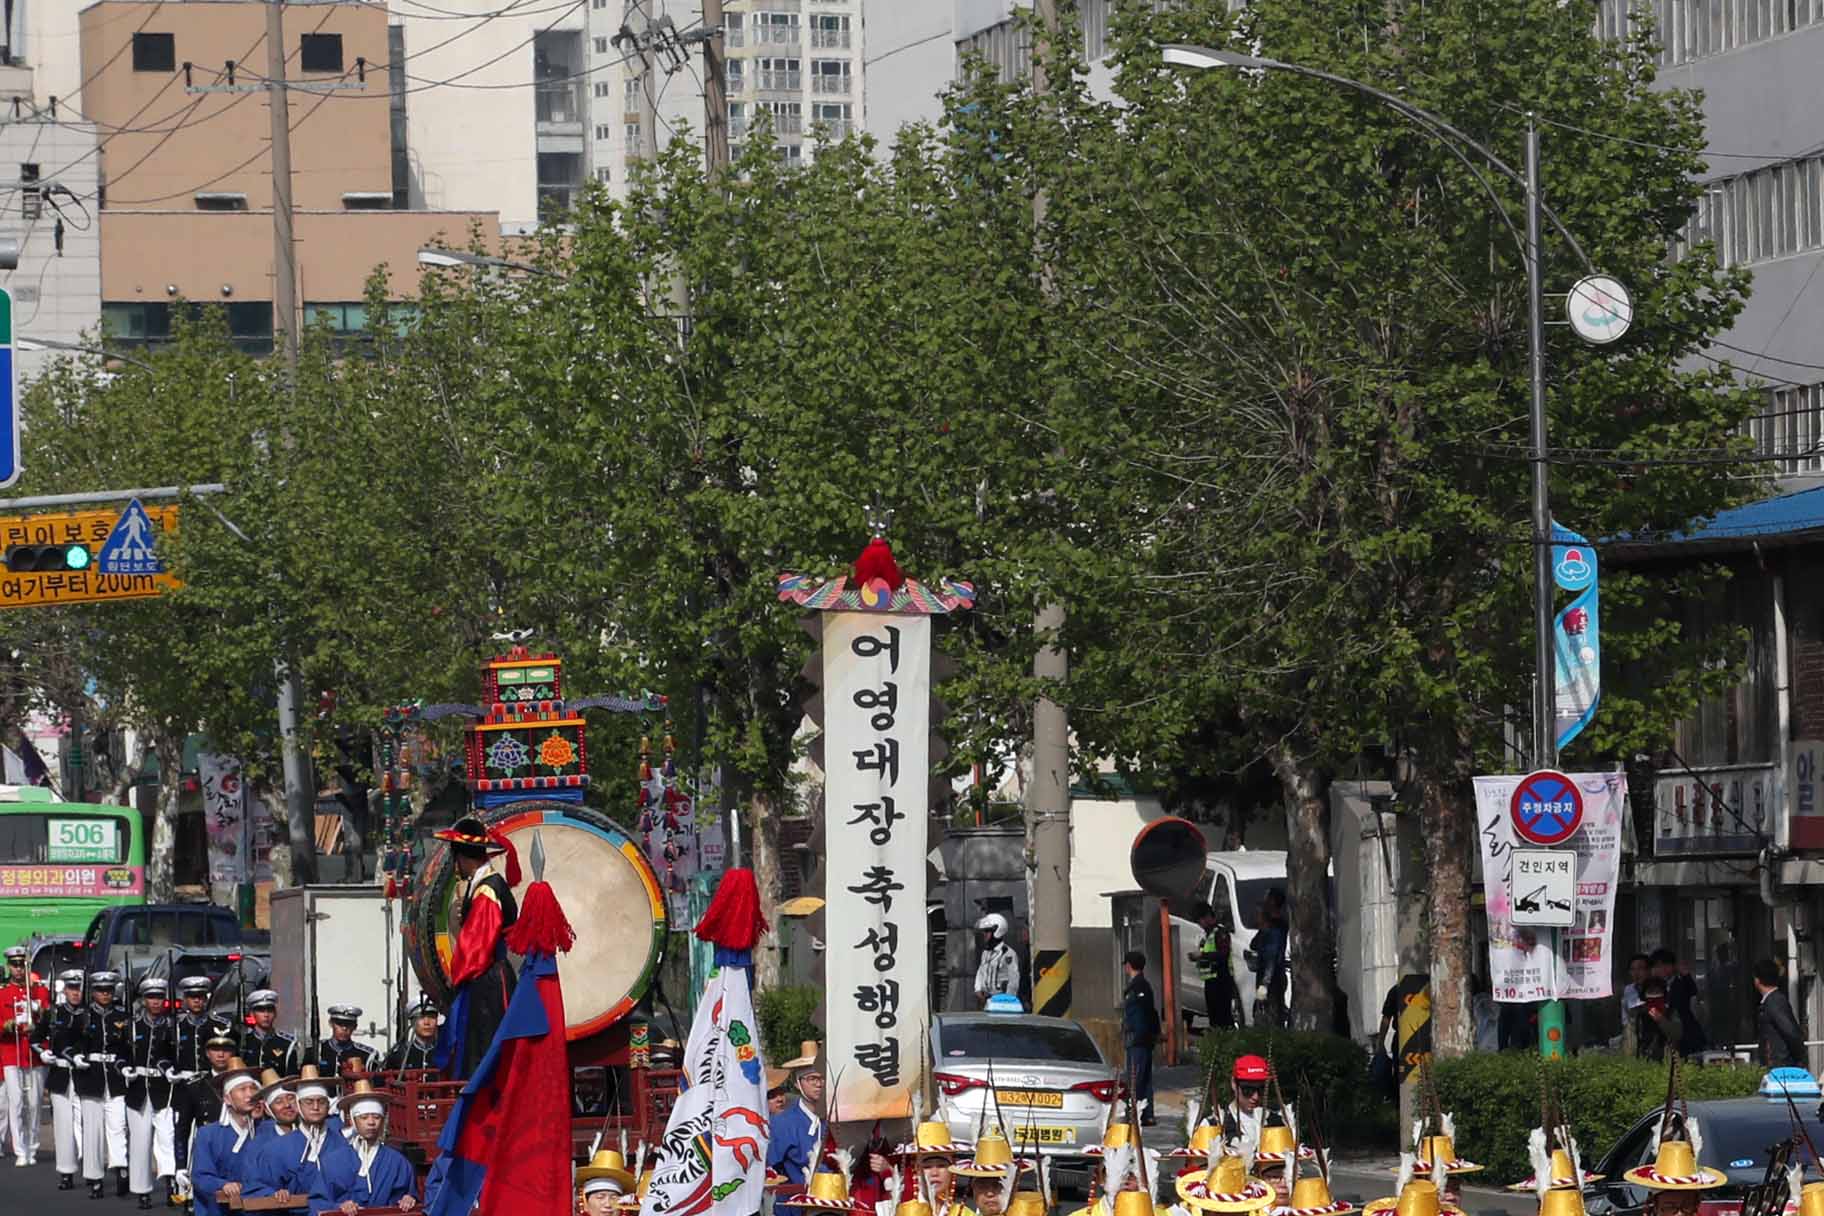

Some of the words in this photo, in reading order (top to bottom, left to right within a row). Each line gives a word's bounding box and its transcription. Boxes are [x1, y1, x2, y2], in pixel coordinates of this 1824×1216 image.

[0, 524, 54, 549] 린이
[2, 572, 88, 600] 여기부터
[96, 573, 154, 594] 200m
[1522, 802, 1574, 814] 주정차금지
[60, 823, 104, 845] 506
[1519, 860, 1569, 873] 견인지역
